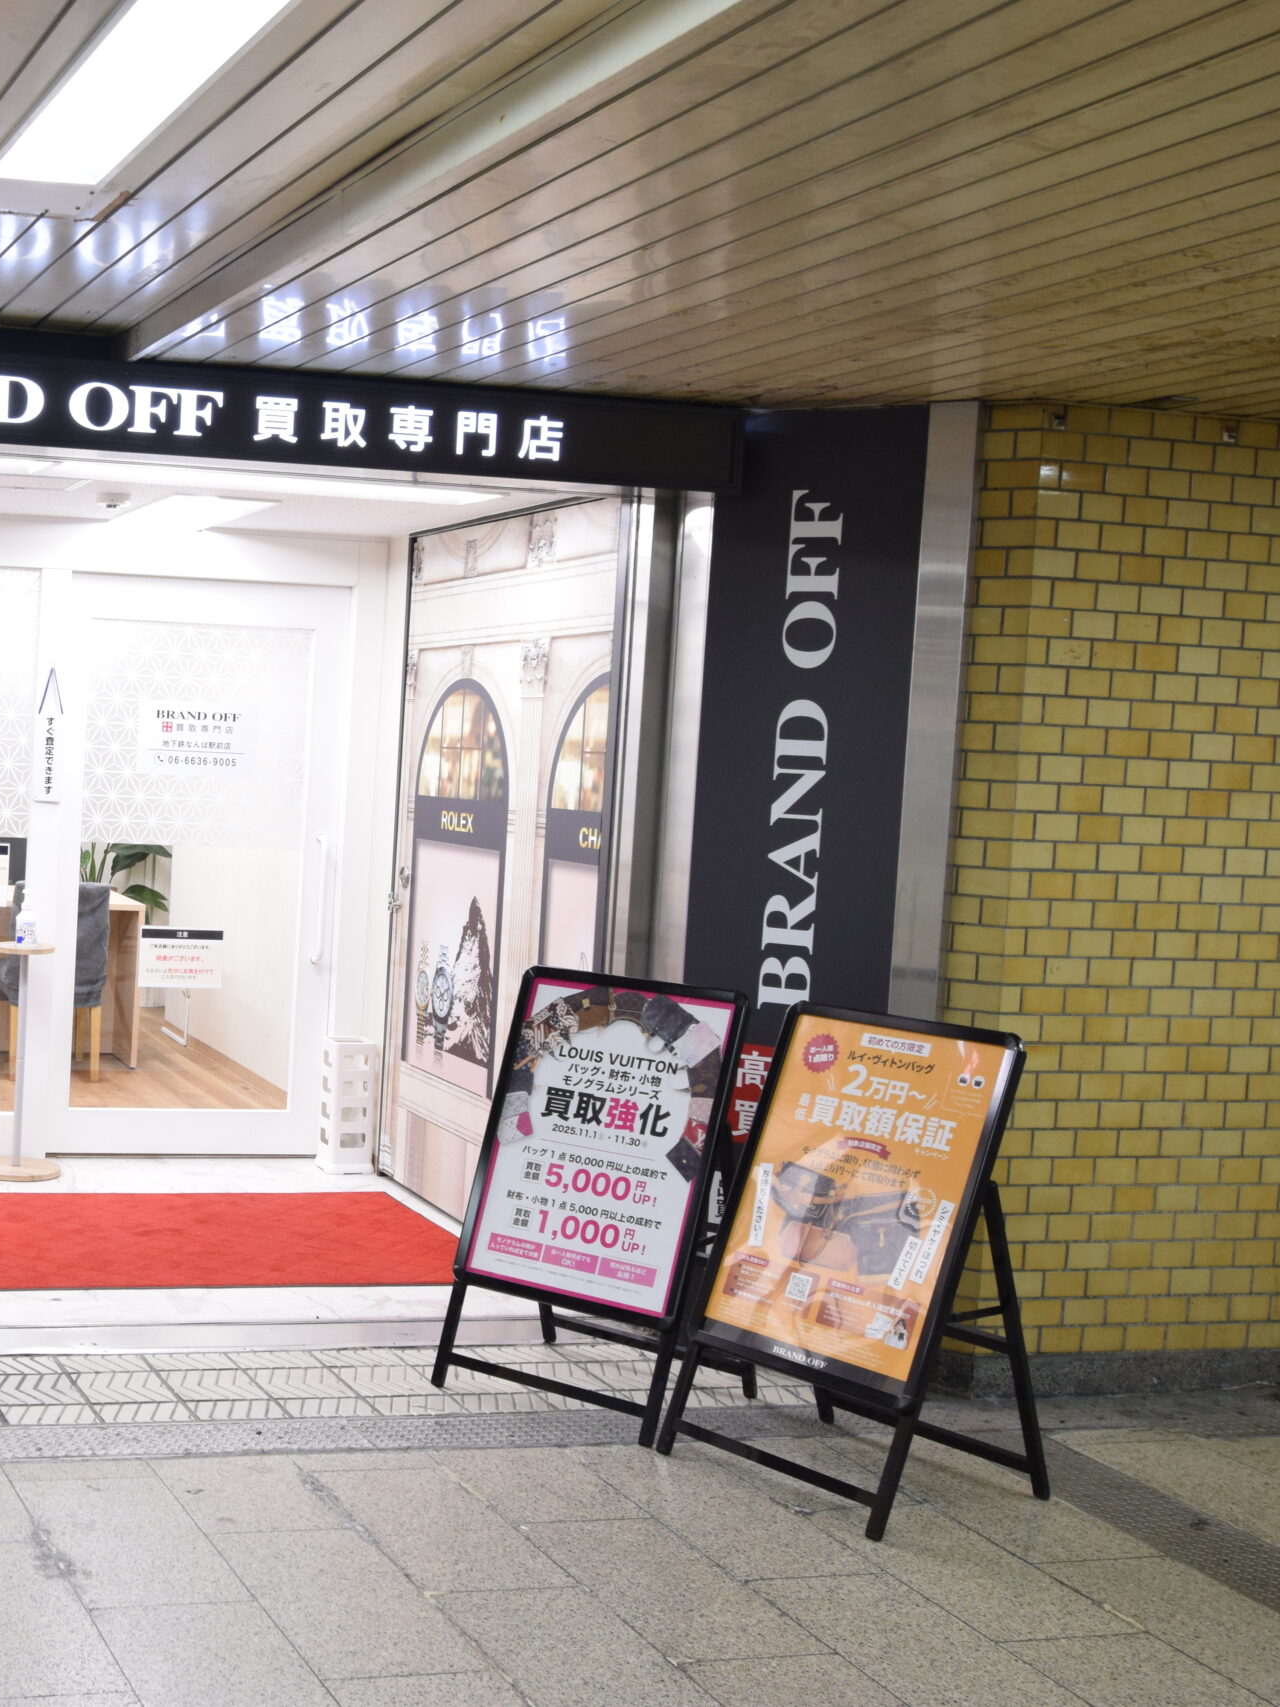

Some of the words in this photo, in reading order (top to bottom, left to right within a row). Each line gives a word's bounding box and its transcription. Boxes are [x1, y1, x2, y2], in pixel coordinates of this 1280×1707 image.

[68, 381, 224, 437] OFF
[253, 395, 565, 462] 買取専門店
[782, 489, 844, 669] OFF
[156, 709, 208, 721] BRAND
[212, 712, 241, 723] OFF
[44, 717, 55, 795] すぐ査定できます
[162, 740, 231, 751] 地下鉄なんば駅前店
[168, 756, 237, 767] 06-6636-9005
[440, 810, 474, 834] ROLEX
[757, 698, 829, 1011] BRAND
[867, 1036, 925, 1054] 初めての方限定
[558, 1044, 604, 1064] LOUIS
[609, 1052, 679, 1076] VUITTON
[846, 1051, 936, 1074] ルイ・ヴィトンバッグ
[562, 1075, 660, 1101] モノグラムシリーズ
[541, 1087, 671, 1138] 買取強化
[808, 1095, 957, 1151] 買取額保証
[544, 1163, 631, 1201] 5,000
[635, 1181, 646, 1192] 円
[538, 1210, 620, 1249] 1,000
[624, 1229, 635, 1240] 円
[773, 1345, 806, 1363] BRAND
[807, 1357, 828, 1370] OFF
